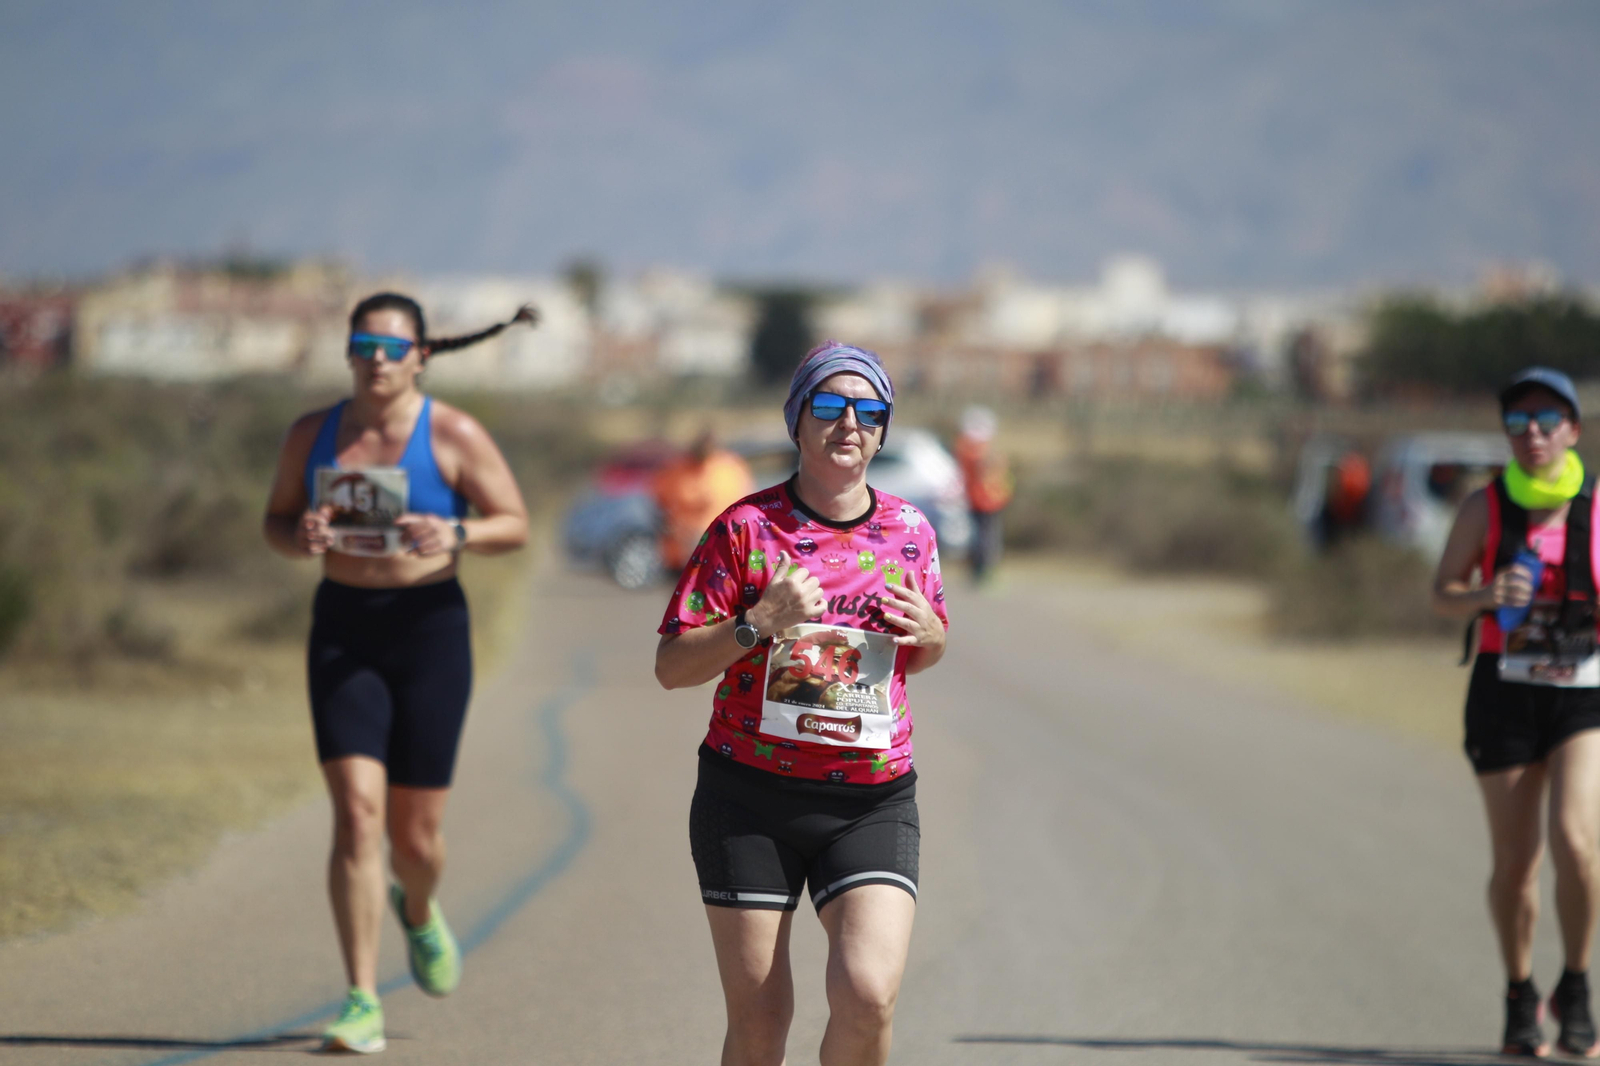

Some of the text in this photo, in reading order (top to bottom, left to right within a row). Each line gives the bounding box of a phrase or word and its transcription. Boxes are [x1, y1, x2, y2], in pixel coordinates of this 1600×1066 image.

[788, 640, 862, 685] 546
[836, 691, 877, 701] CARRERA
[836, 697, 877, 706] POPULAR
